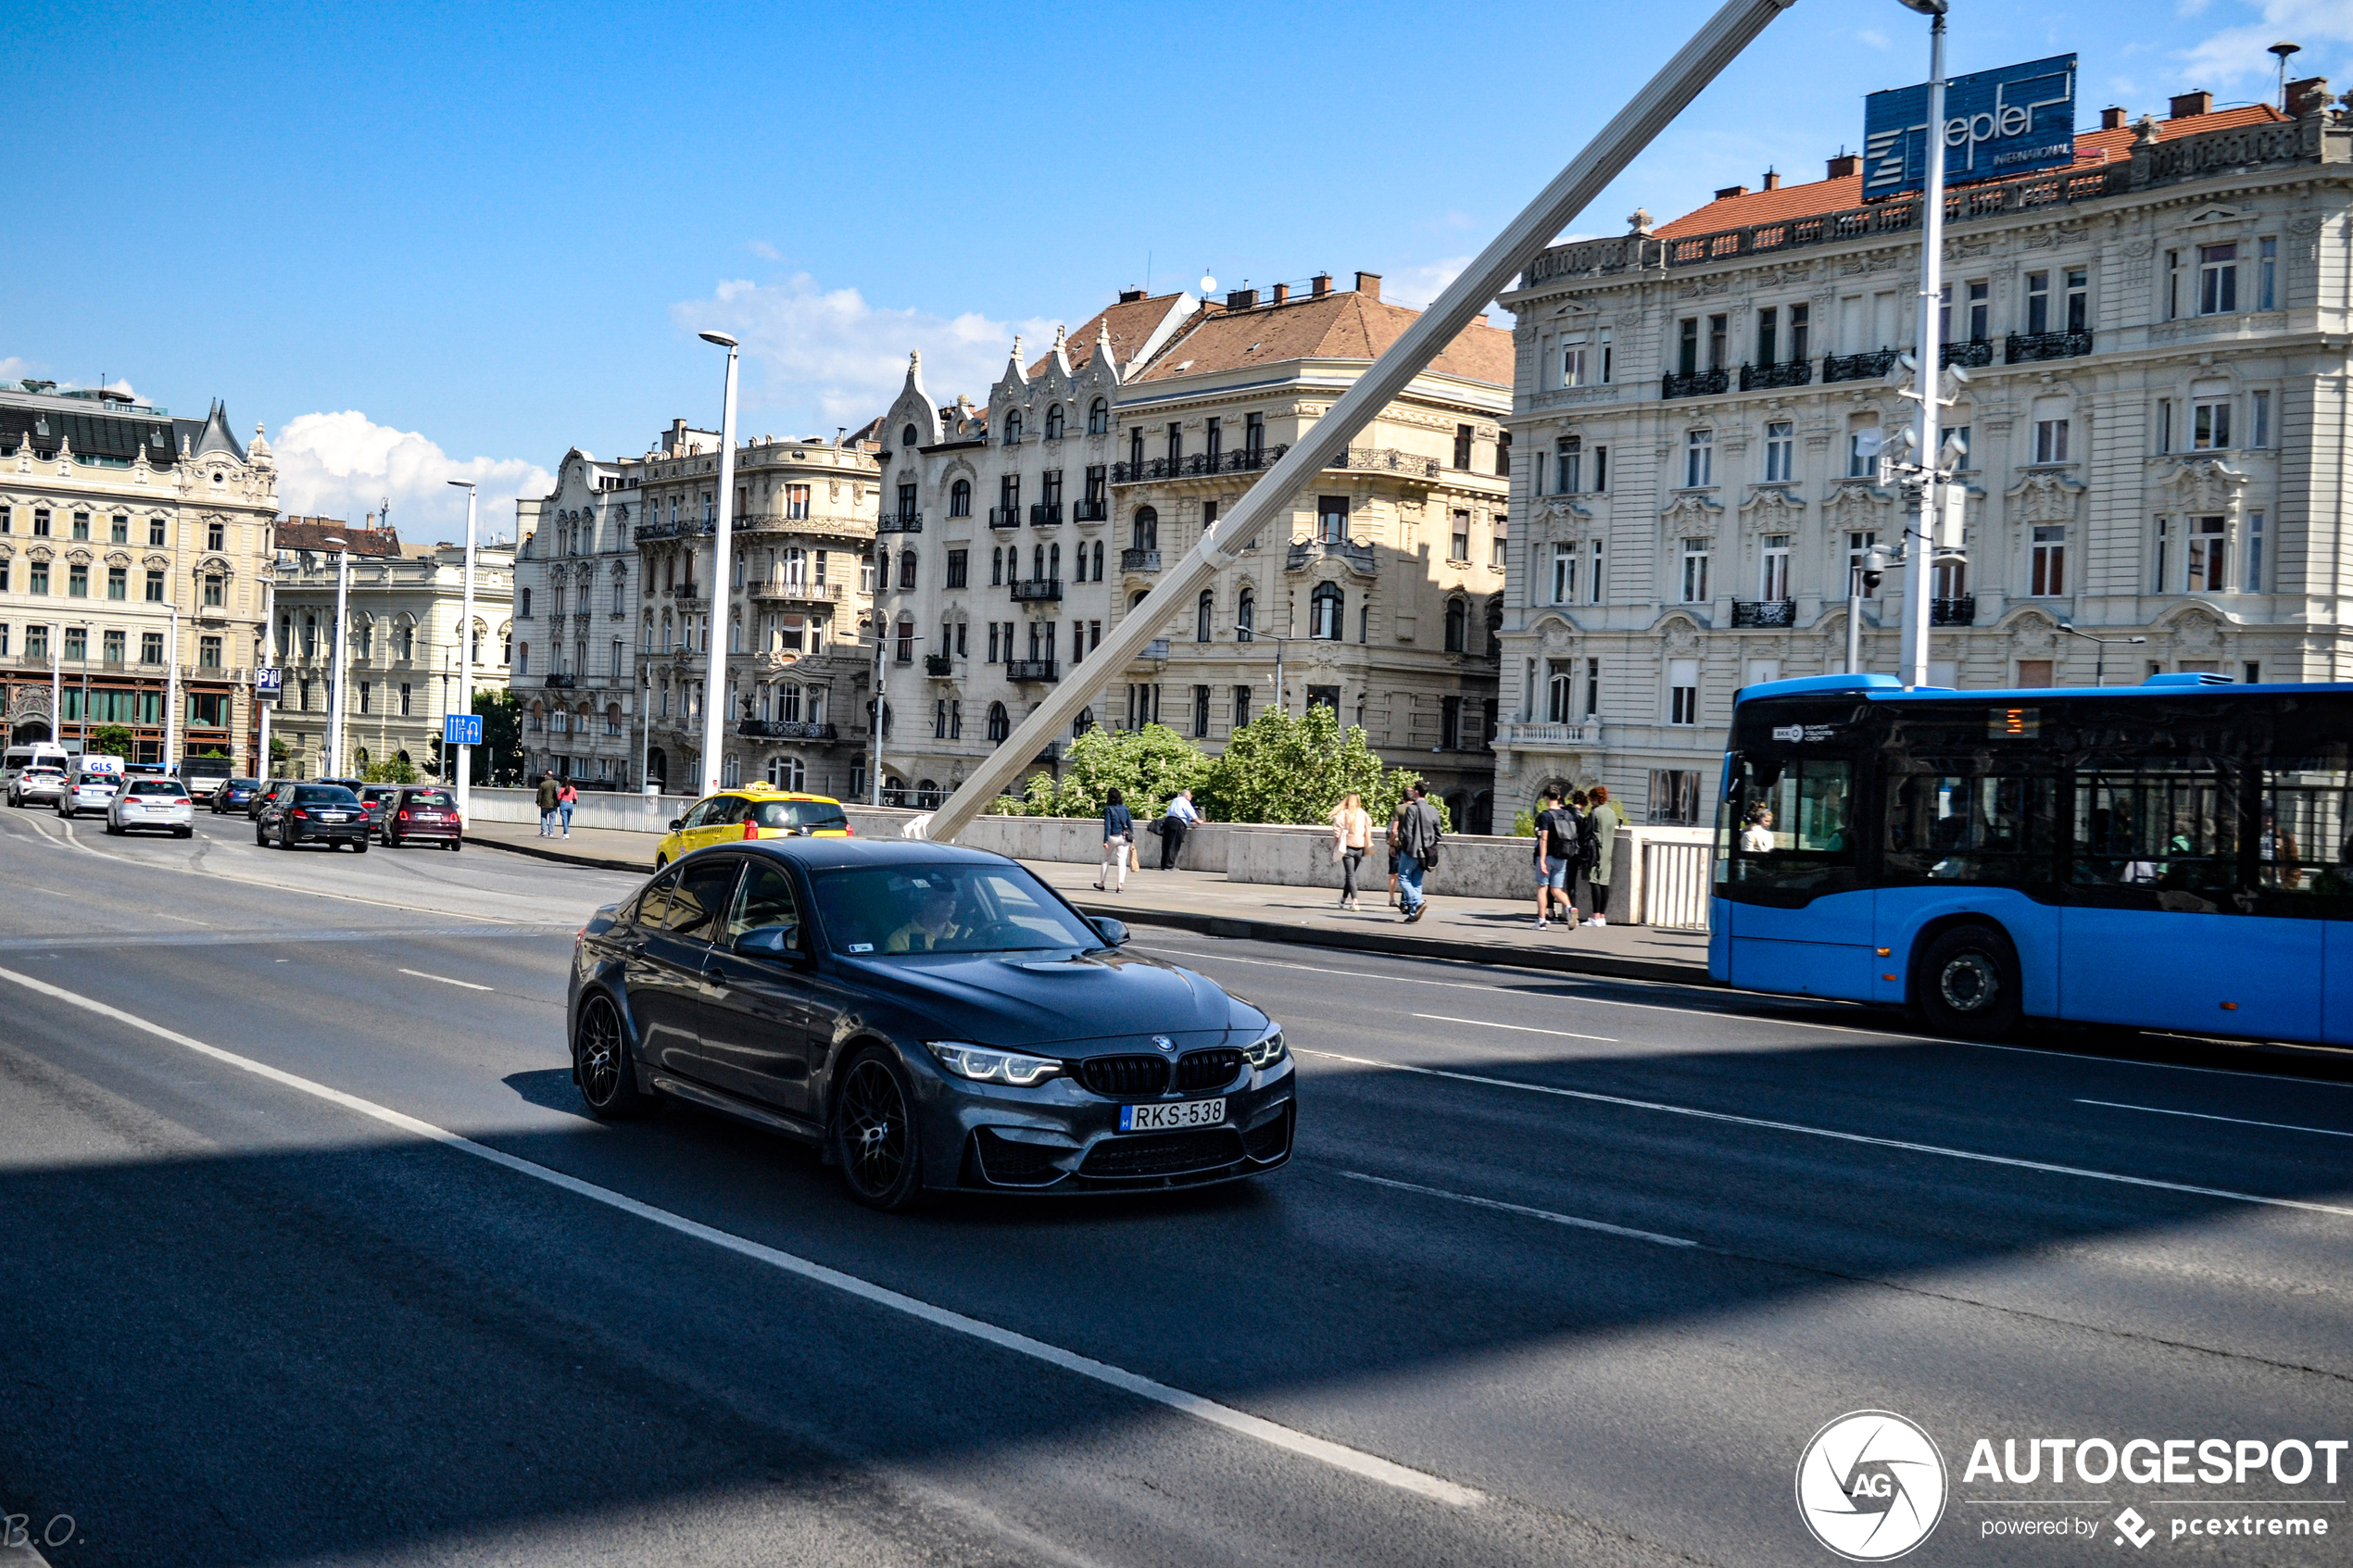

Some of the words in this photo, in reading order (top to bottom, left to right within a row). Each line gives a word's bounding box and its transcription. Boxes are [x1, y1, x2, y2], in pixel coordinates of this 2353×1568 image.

[1993, 143, 2070, 165] INTERNATIONAL
[90, 762, 112, 771] GLS
[1136, 1100, 1222, 1127] RKS-538
